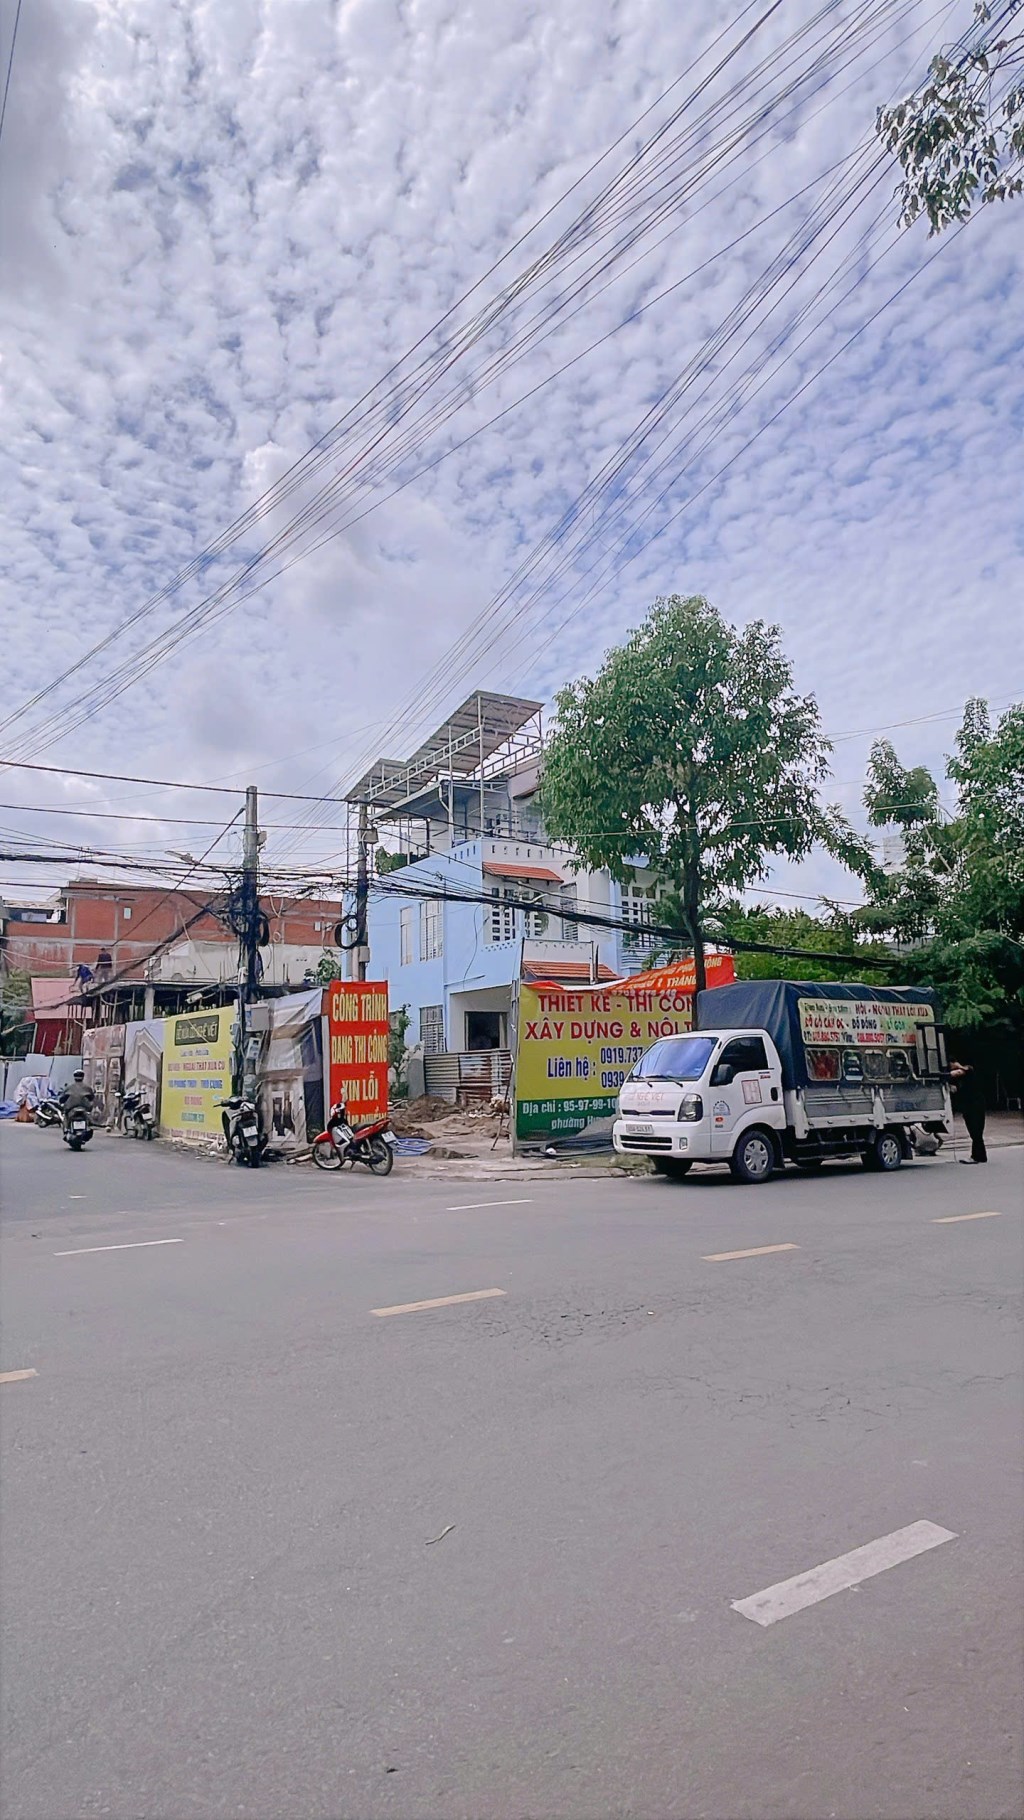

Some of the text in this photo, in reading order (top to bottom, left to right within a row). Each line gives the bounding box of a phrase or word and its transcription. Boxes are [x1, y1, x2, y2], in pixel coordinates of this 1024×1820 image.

[332, 987, 387, 1022] CÔNG TRÌNH
[525, 1017, 565, 1040] XÂY
[571, 1019, 623, 1044] DỰNG
[630, 1021, 641, 1037] &
[354, 1035, 367, 1064] THI
[547, 1057, 572, 1077] Liên
[575, 1056, 589, 1080] hệ
[362, 1071, 379, 1100] LỖI
[522, 1102, 539, 1117] Địa
